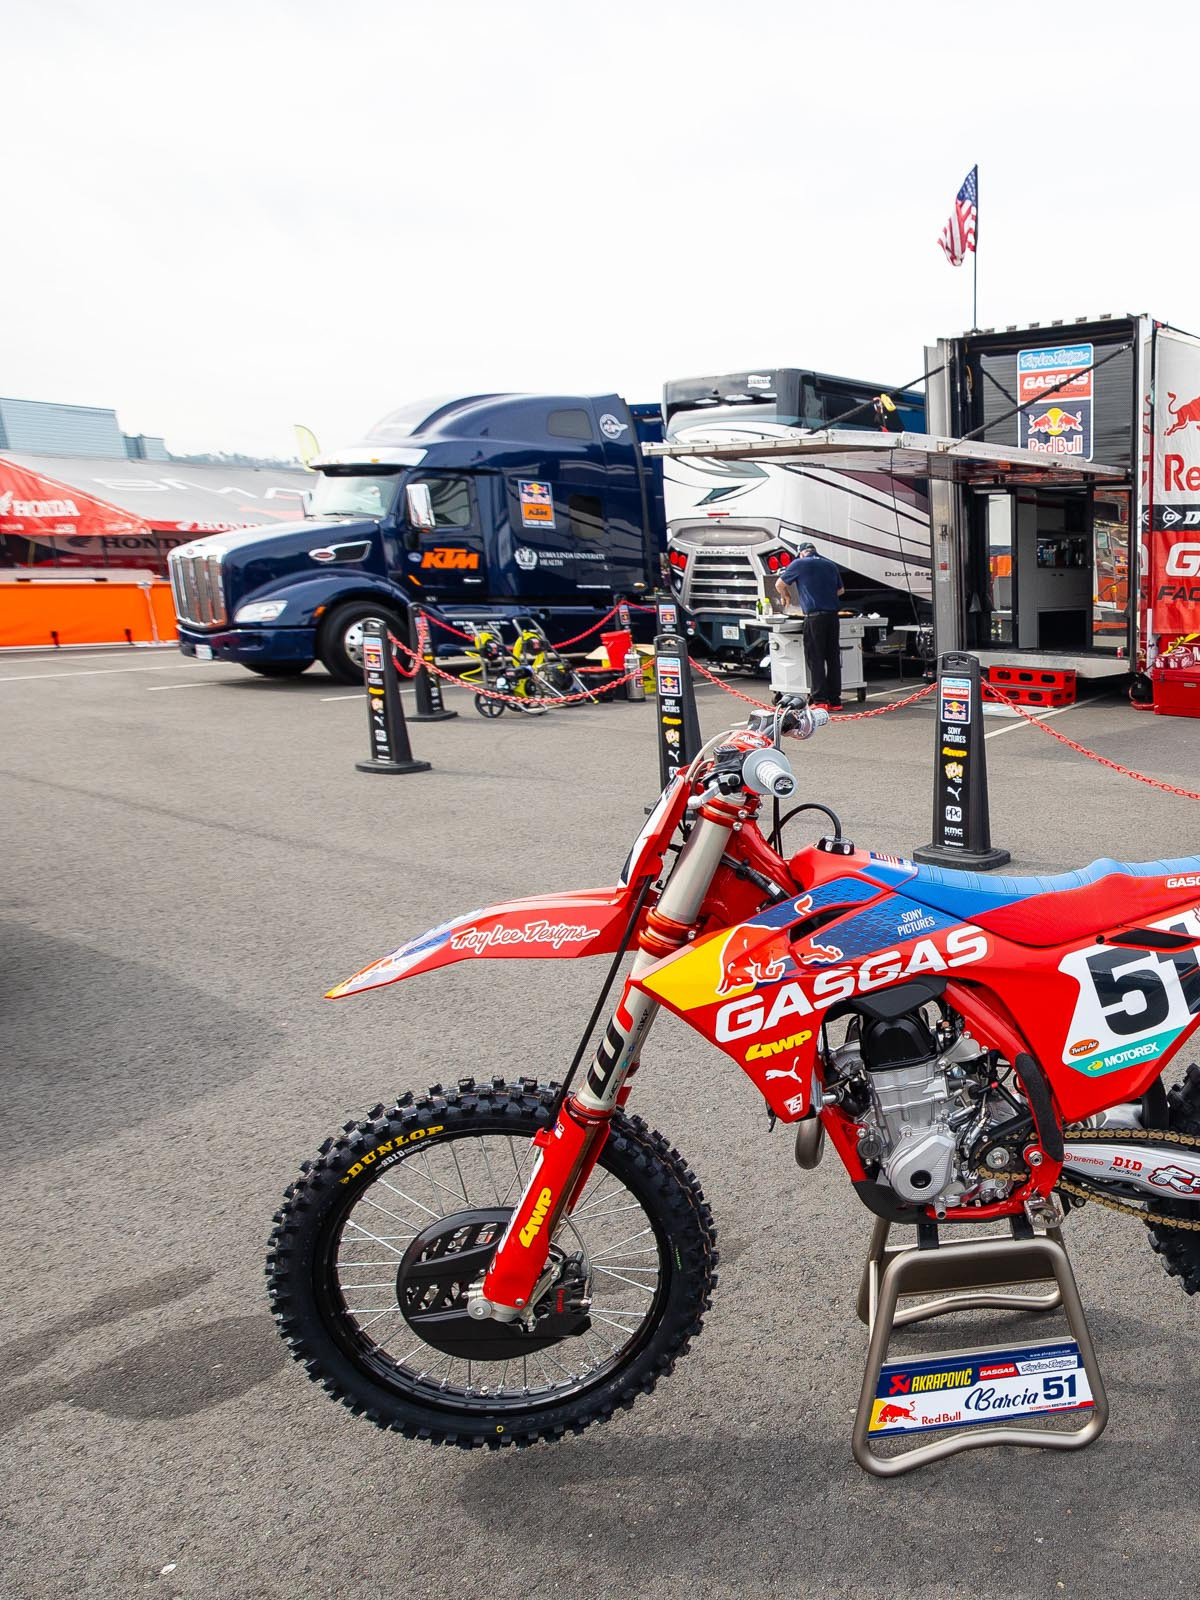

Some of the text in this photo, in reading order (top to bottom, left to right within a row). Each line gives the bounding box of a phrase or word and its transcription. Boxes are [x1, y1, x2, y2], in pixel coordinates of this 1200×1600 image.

[1023, 372, 1089, 389] GASGAS
[1028, 434, 1083, 454] Red Bull
[13, 500, 80, 517] HONDA
[420, 547, 479, 569] KTM
[943, 734, 966, 743] PICTURES
[947, 726, 961, 735] SONY
[946, 807, 961, 819] PPG
[901, 908, 923, 923] SONY
[897, 916, 936, 937] PICTURES
[451, 920, 600, 954] Troy Lee Designs
[715, 925, 988, 1043] GASGAS
[744, 1029, 812, 1062] 4WP
[1069, 1041, 1098, 1056] Twin Air
[1104, 1042, 1160, 1067] MOTOREX
[347, 1125, 444, 1178] DUNLOP
[1073, 1155, 1104, 1165] brembo
[518, 1187, 552, 1248] 4WP
[979, 1366, 1015, 1377] GASGAS
[964, 1374, 1077, 1411] Barcia 51
[921, 1411, 961, 1425] Red Bull
